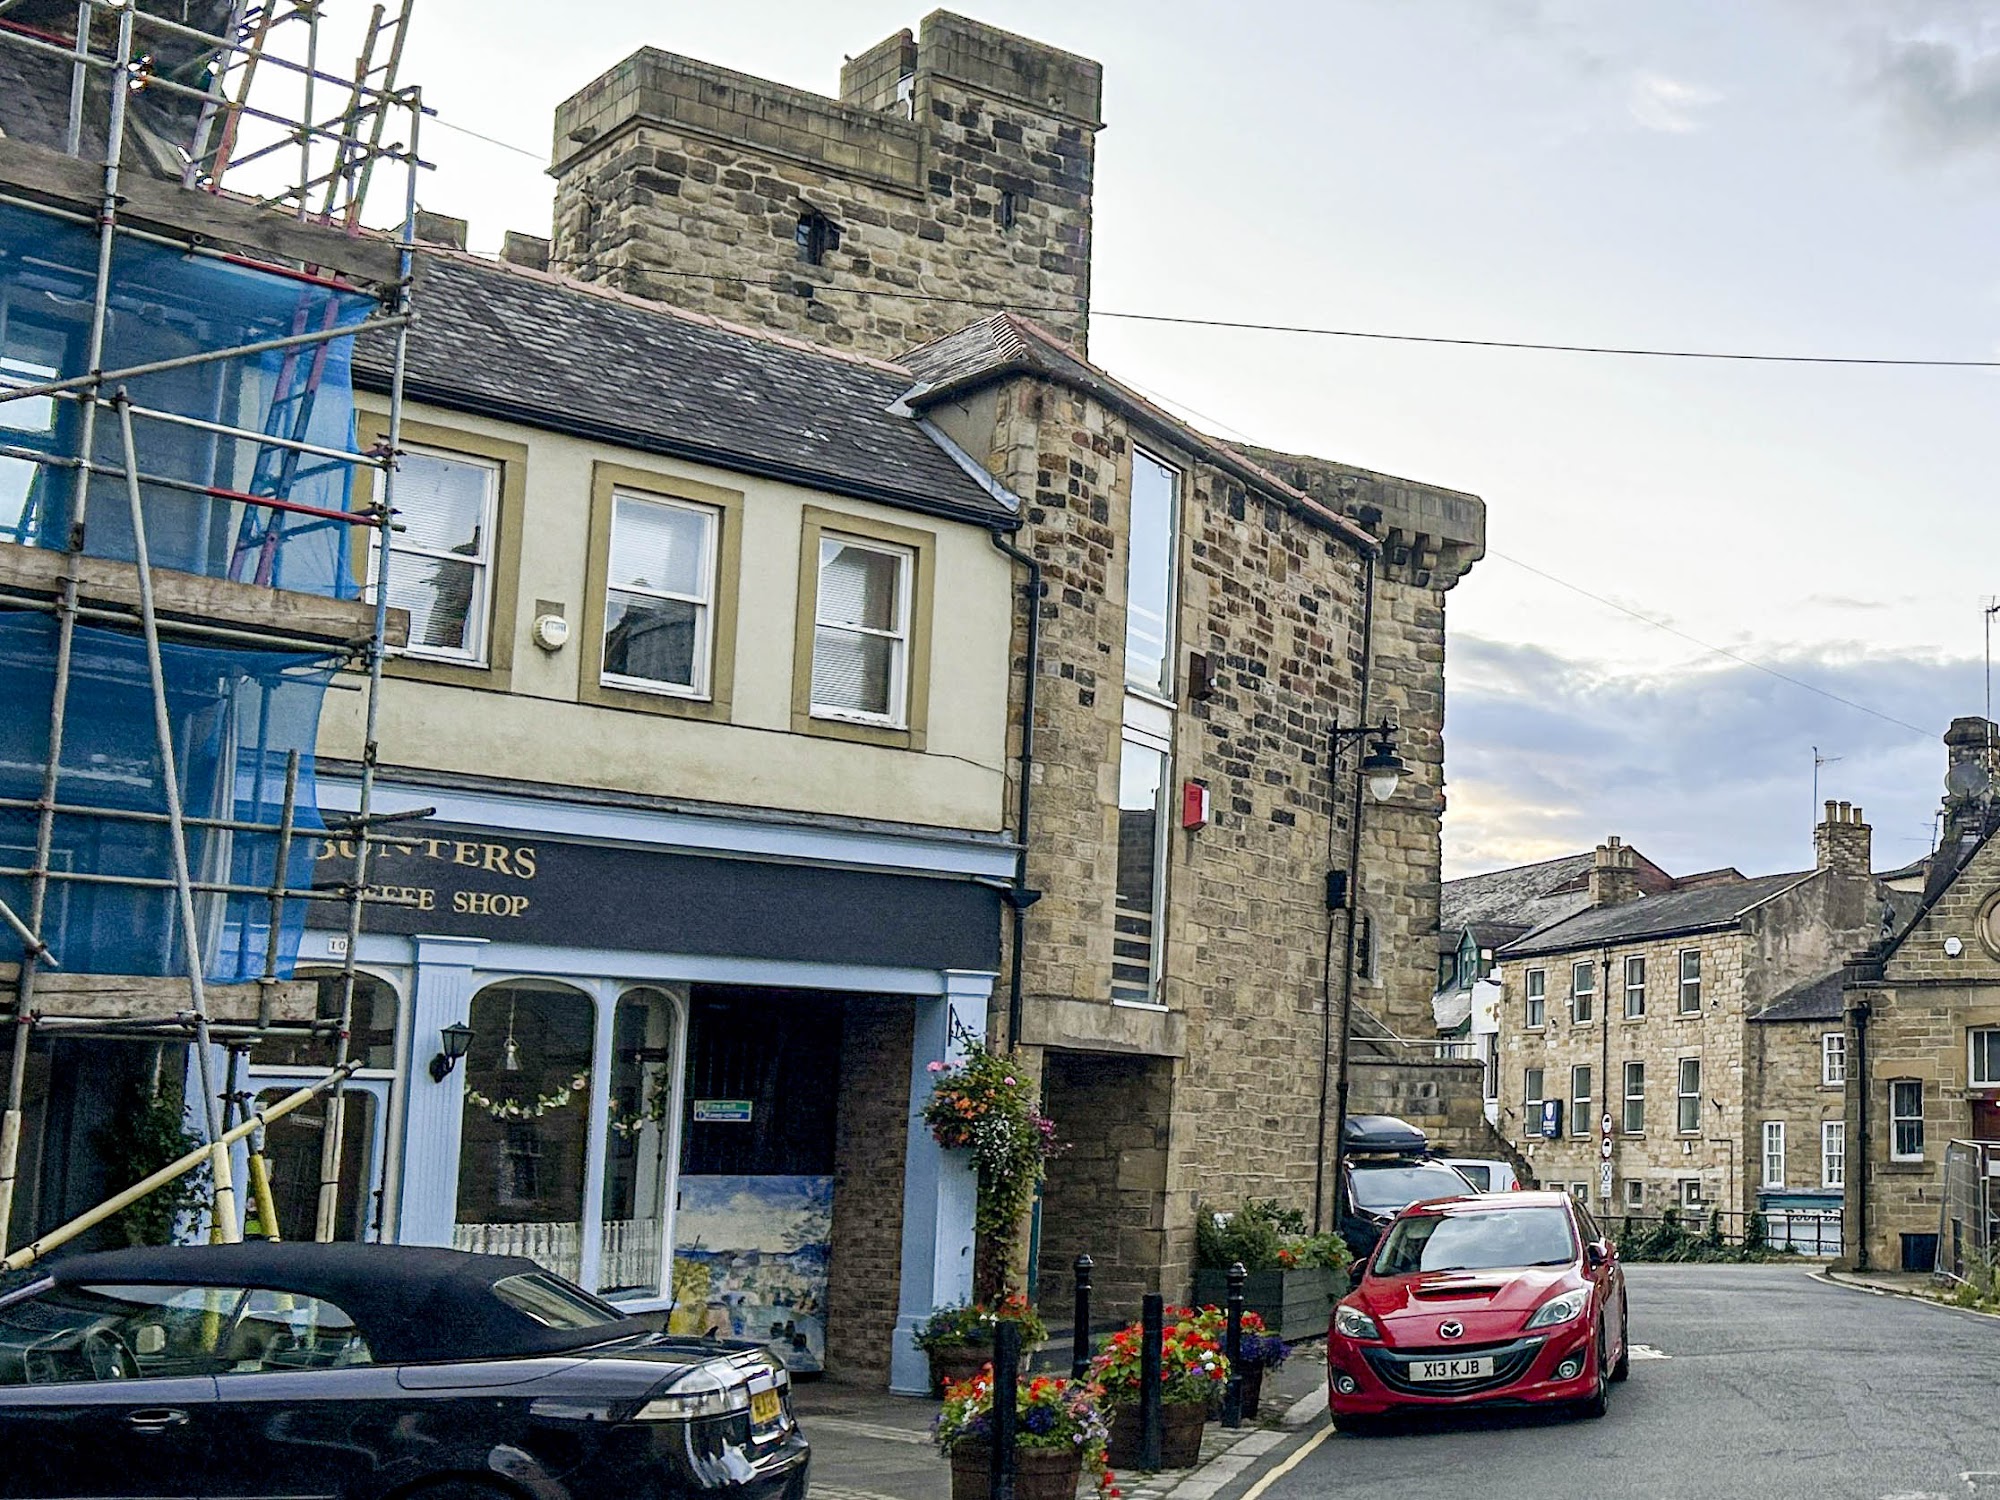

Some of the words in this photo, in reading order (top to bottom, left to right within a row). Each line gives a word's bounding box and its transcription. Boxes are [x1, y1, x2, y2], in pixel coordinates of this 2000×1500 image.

[452, 890, 530, 917] SHOP
[331, 940, 346, 950] 10
[1424, 1362, 1446, 1377] X13
[1450, 1360, 1479, 1376] KJB
